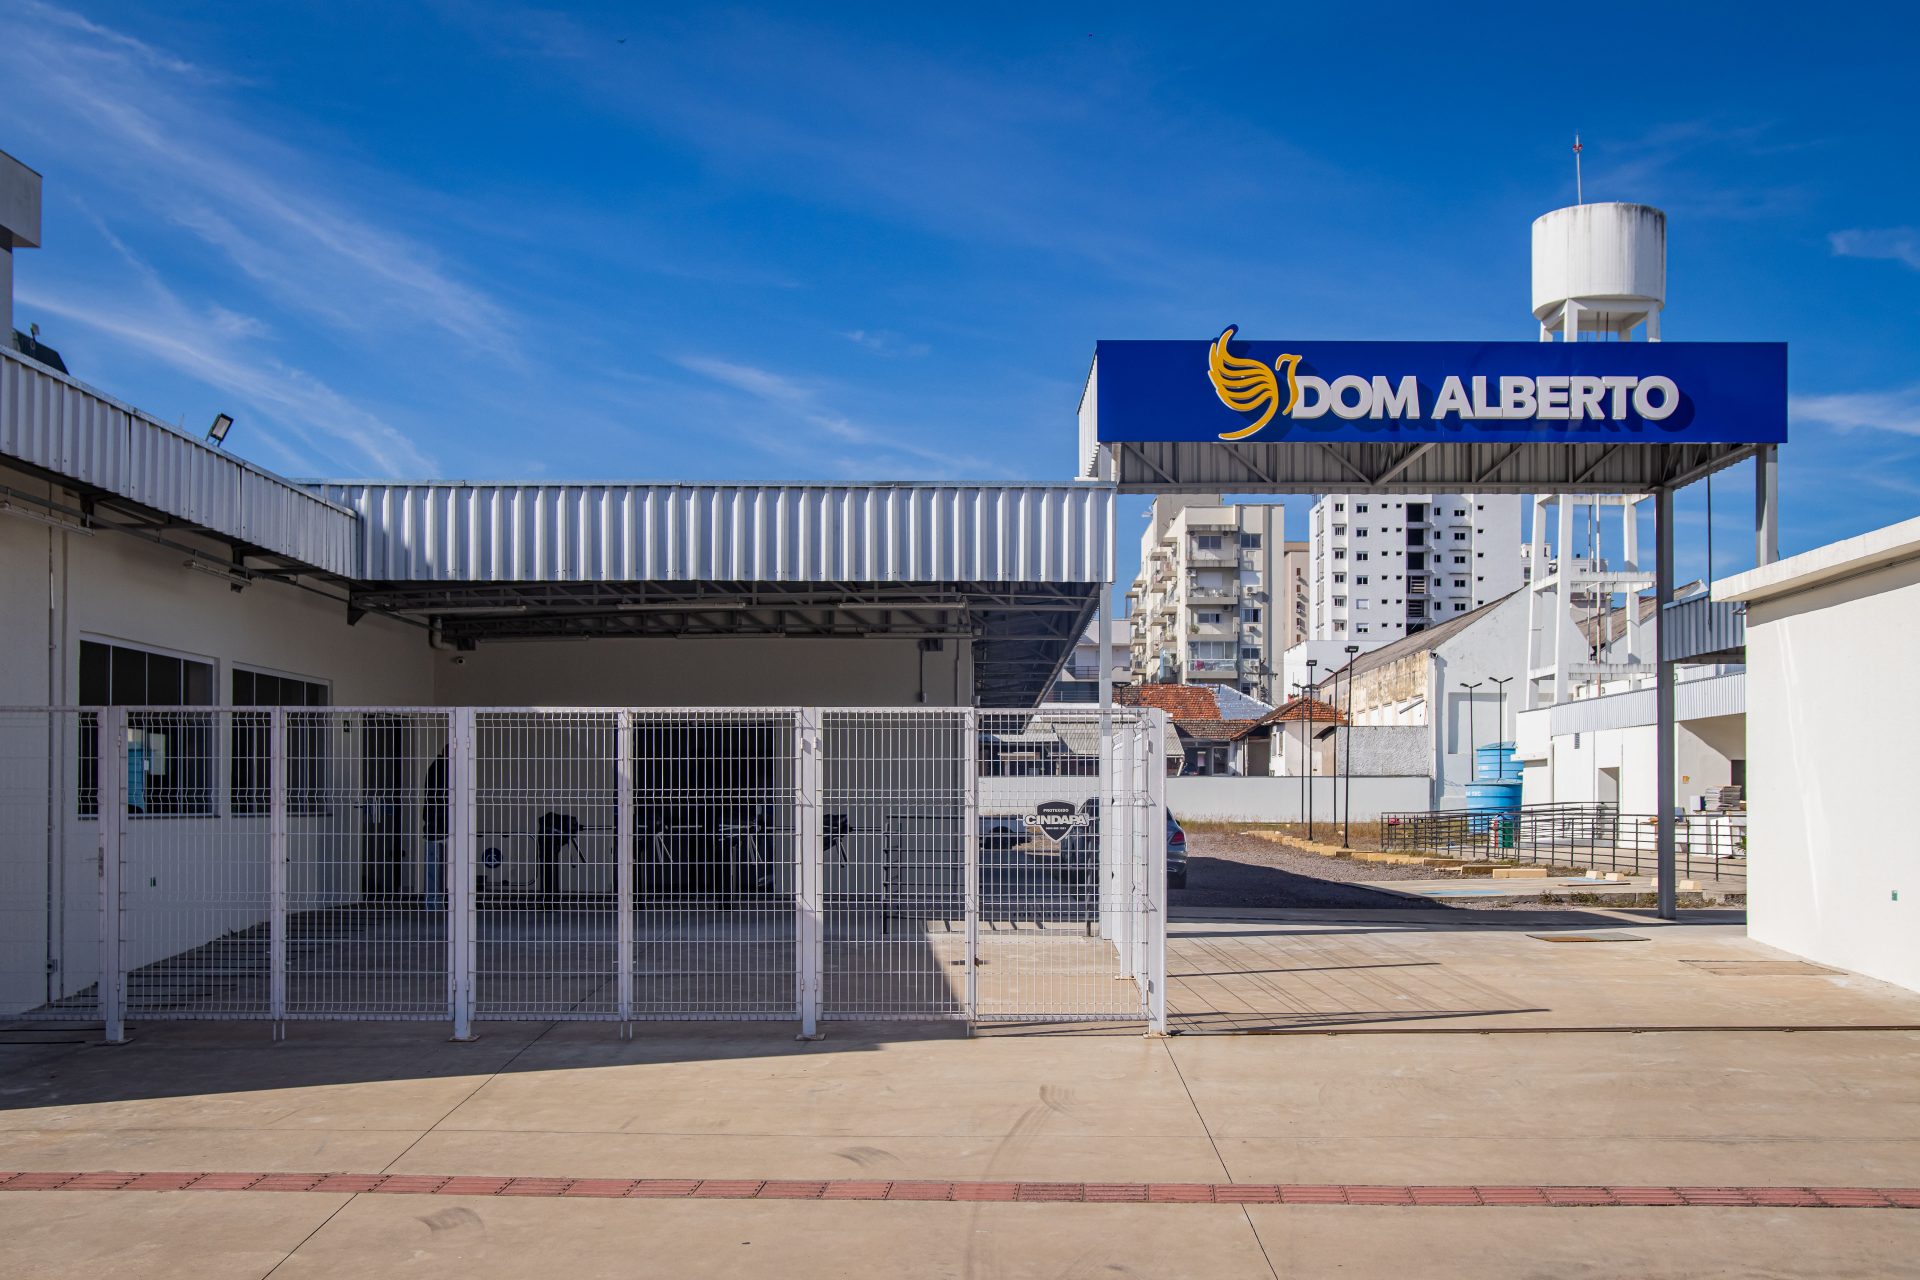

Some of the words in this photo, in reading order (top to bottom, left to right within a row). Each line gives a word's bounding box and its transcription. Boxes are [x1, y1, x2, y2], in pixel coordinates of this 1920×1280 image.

[1291, 375, 1421, 420] DOM
[1431, 375, 1680, 420] ALBERTO
[1026, 814, 1086, 825] CINDAPA
